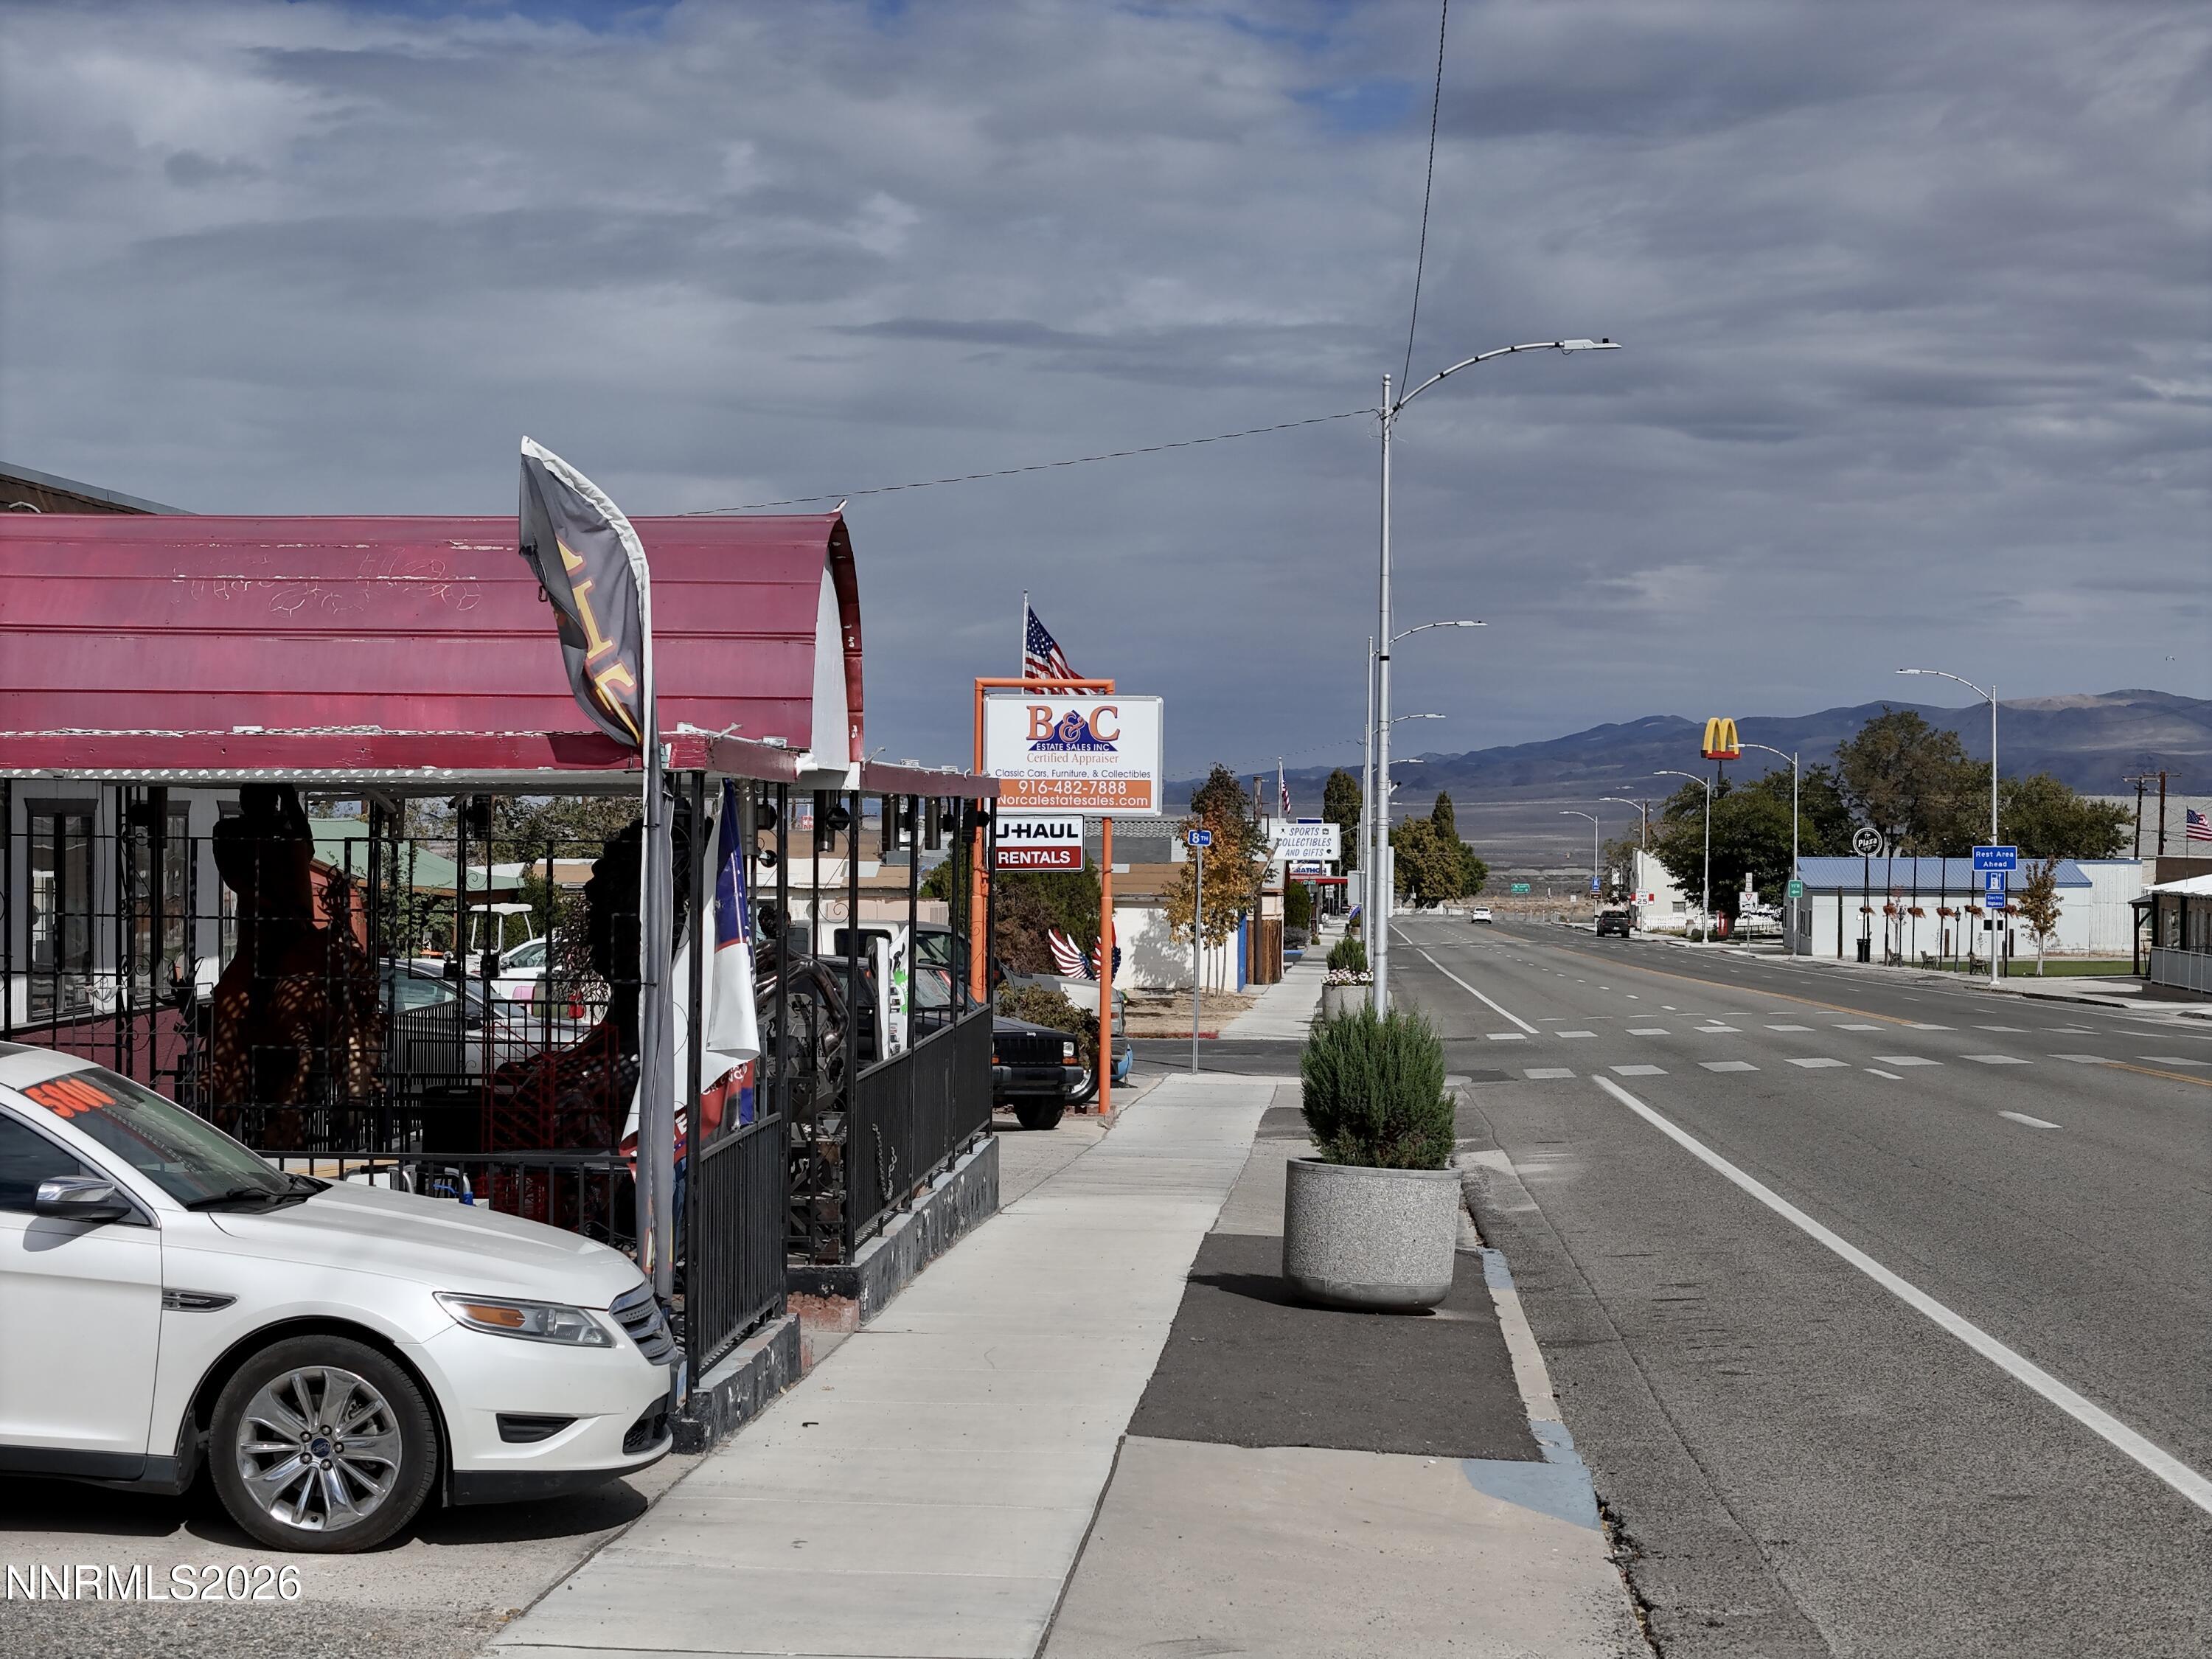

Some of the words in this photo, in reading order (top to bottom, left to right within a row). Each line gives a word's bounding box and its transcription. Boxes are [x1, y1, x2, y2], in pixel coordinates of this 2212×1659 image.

[1026, 706, 1121, 743] B&C
[1036, 743, 1064, 751] ESTATE
[1066, 743, 1091, 751] SALES
[1093, 743, 1110, 751] INC
[1027, 753, 1068, 763] Certified
[1071, 754, 1119, 766] Appraiser
[995, 769, 1024, 778] Classic
[1027, 769, 1048, 779] Cars,
[1052, 770, 1090, 779] Furniture,
[1101, 770, 1151, 779] Collectibles
[1018, 780, 1127, 795] 916-482-7888
[998, 794, 1148, 806] Norcalestatesales.com
[1289, 827, 1320, 836] SPORTS
[1278, 838, 1332, 846] COLLECTIBLES
[1858, 838, 1877, 847] Plaza
[998, 851, 1071, 865] RENTALS
[1285, 849, 1300, 857] AND
[1303, 849, 1324, 857] GIFTS
[24, 1078, 116, 1118] 5800
